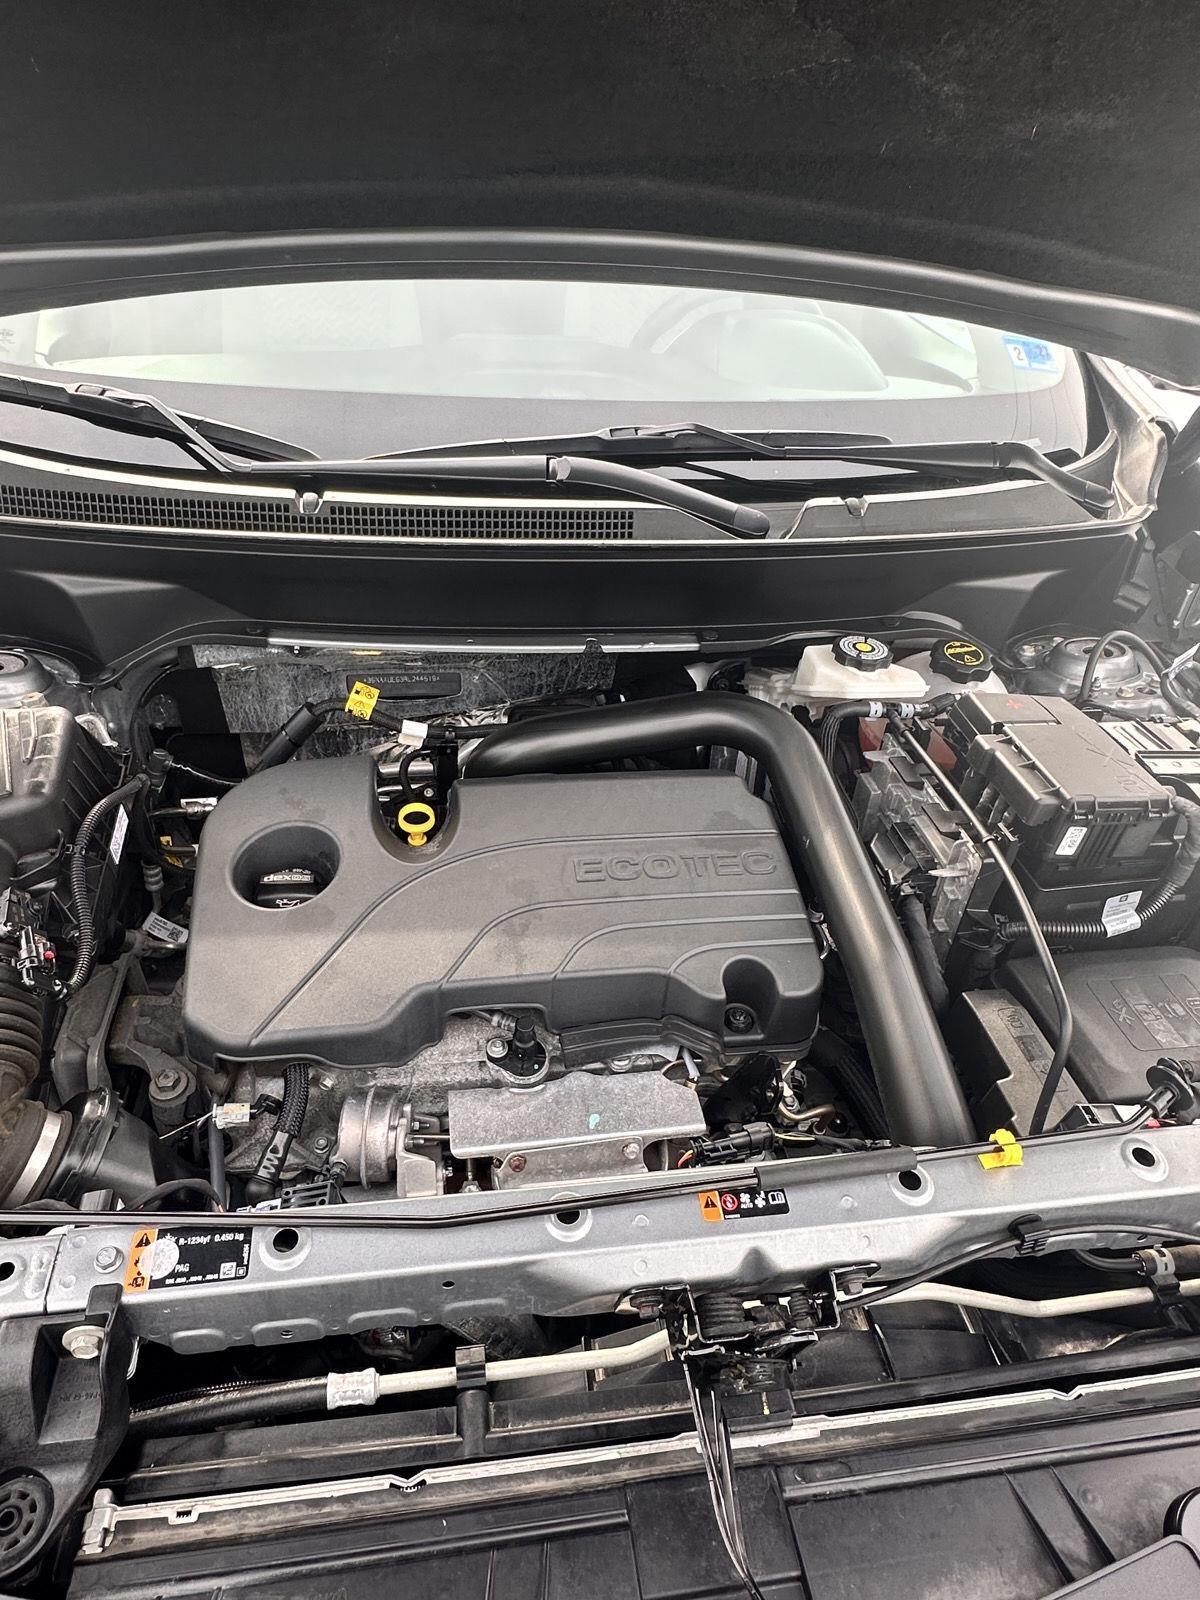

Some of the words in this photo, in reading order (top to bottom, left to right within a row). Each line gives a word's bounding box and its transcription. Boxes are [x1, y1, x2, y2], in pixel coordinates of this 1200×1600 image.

[1013, 346, 1024, 361] 2
[573, 851, 777, 882] ECOTEC
[178, 1234, 211, 1246] R-1234yf
[214, 1233, 234, 1242] 0.450
[235, 1232, 244, 1242] kg
[174, 1263, 190, 1273] PAG
